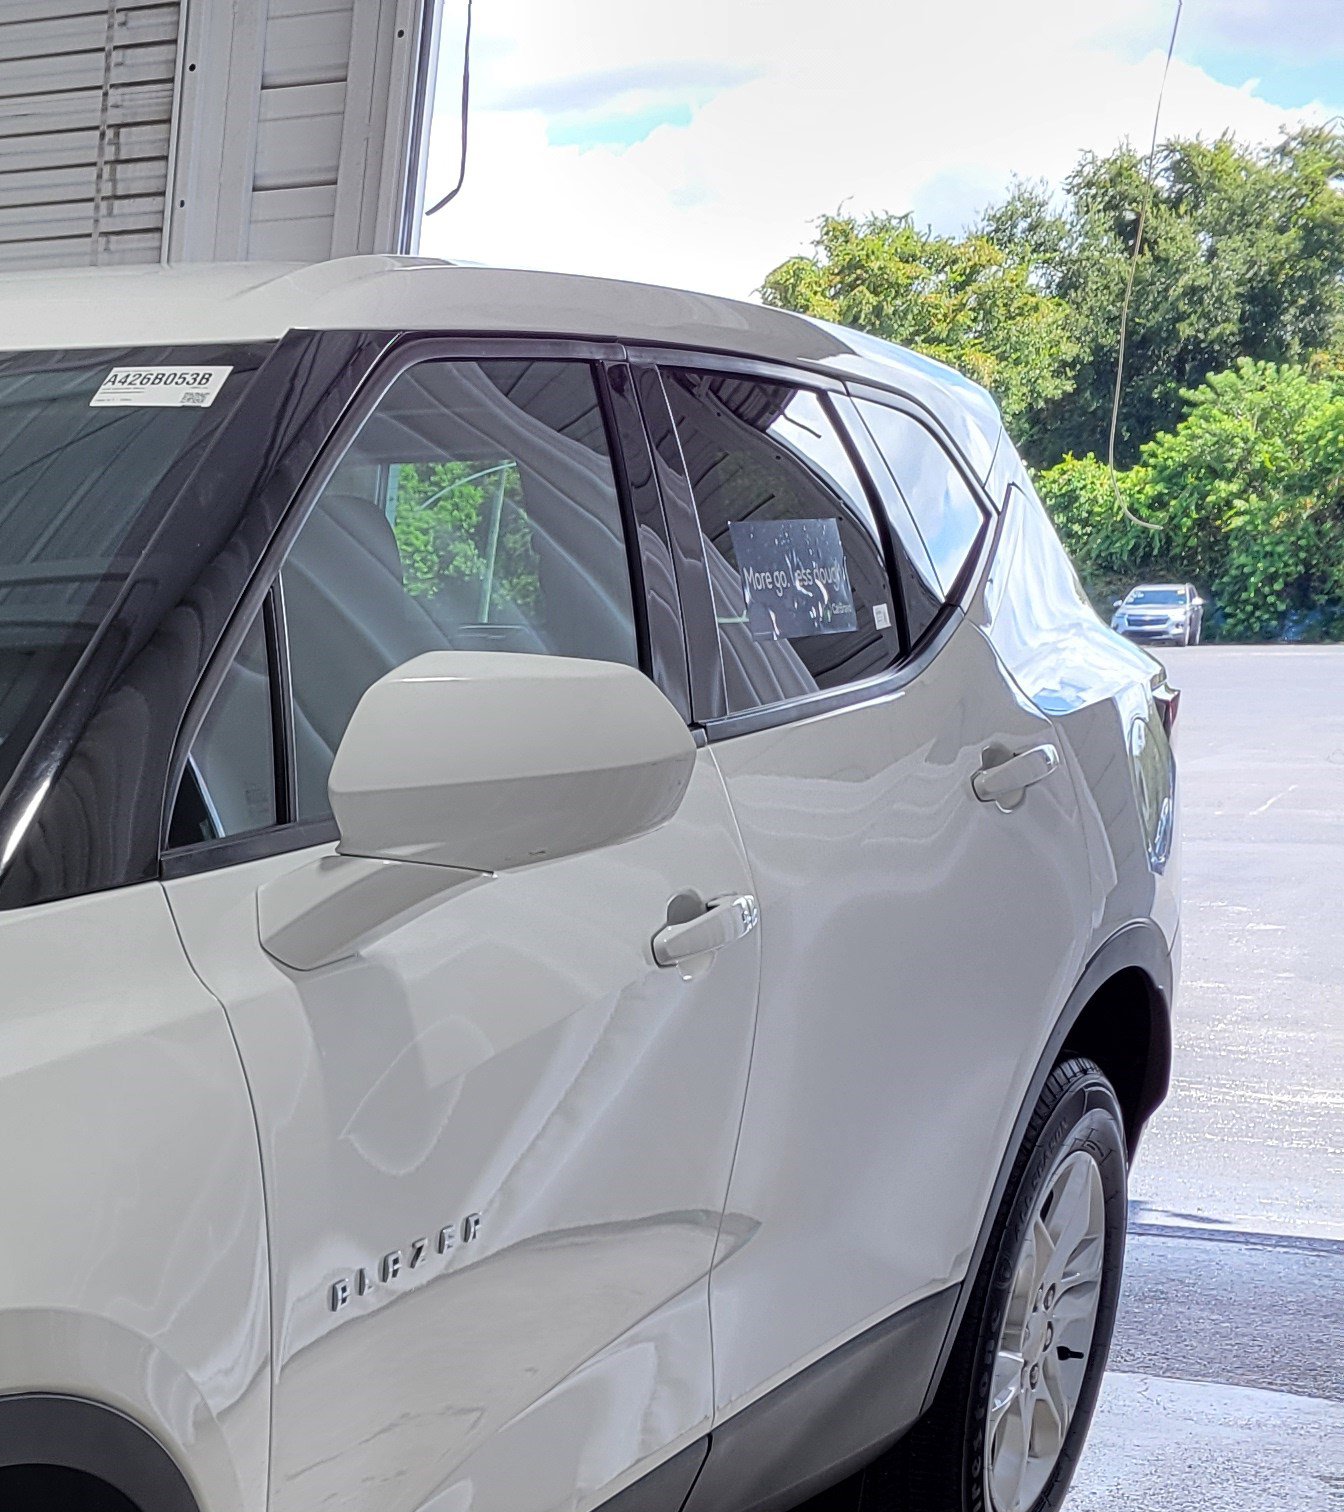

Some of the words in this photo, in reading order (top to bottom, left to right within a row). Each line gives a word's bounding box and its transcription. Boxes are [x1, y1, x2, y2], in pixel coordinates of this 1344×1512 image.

[103, 372, 213, 387] A426B053B
[743, 566, 773, 591] More
[773, 570, 791, 597] go.
[813, 560, 848, 592] doug
[329, 1211, 483, 1312] BLAZER
